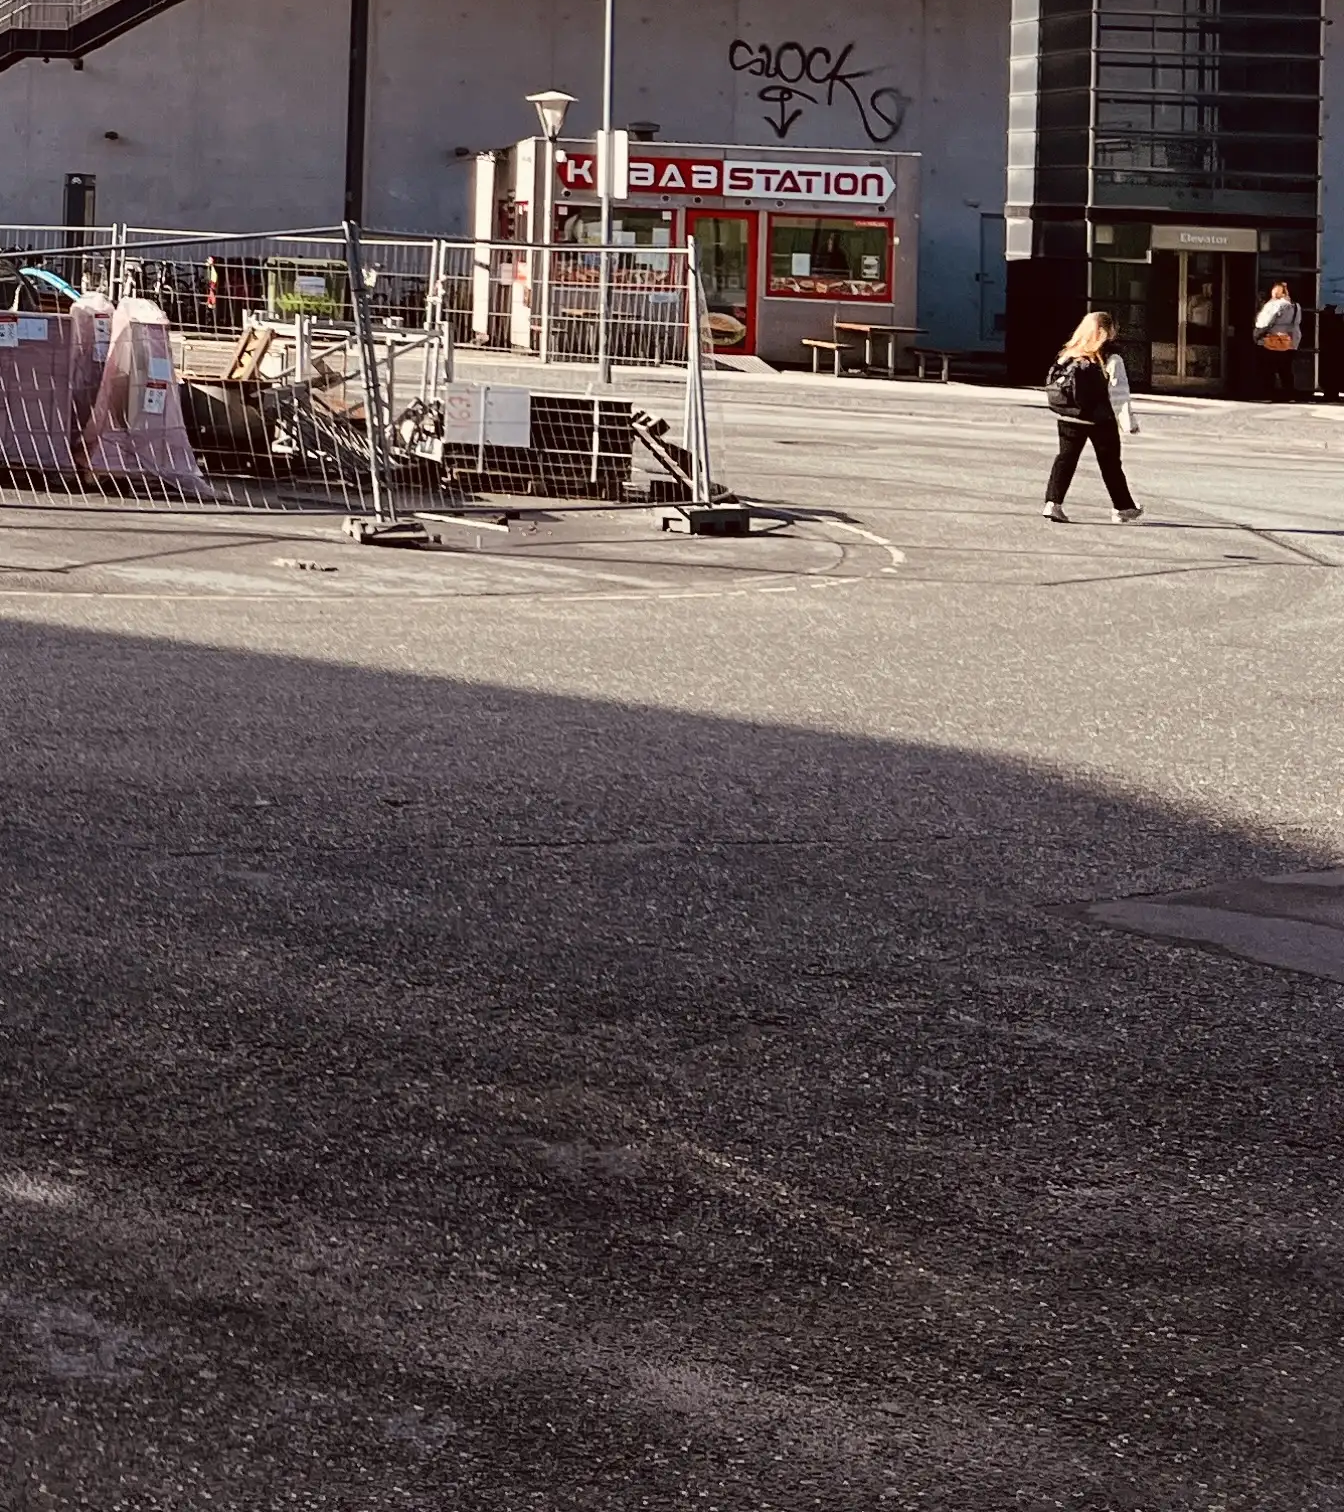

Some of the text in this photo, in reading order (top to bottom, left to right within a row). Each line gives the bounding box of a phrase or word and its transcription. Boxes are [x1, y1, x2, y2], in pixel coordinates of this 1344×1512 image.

[566, 159, 884, 197] KBAB STATION
[1180, 232, 1228, 244] Elevator
